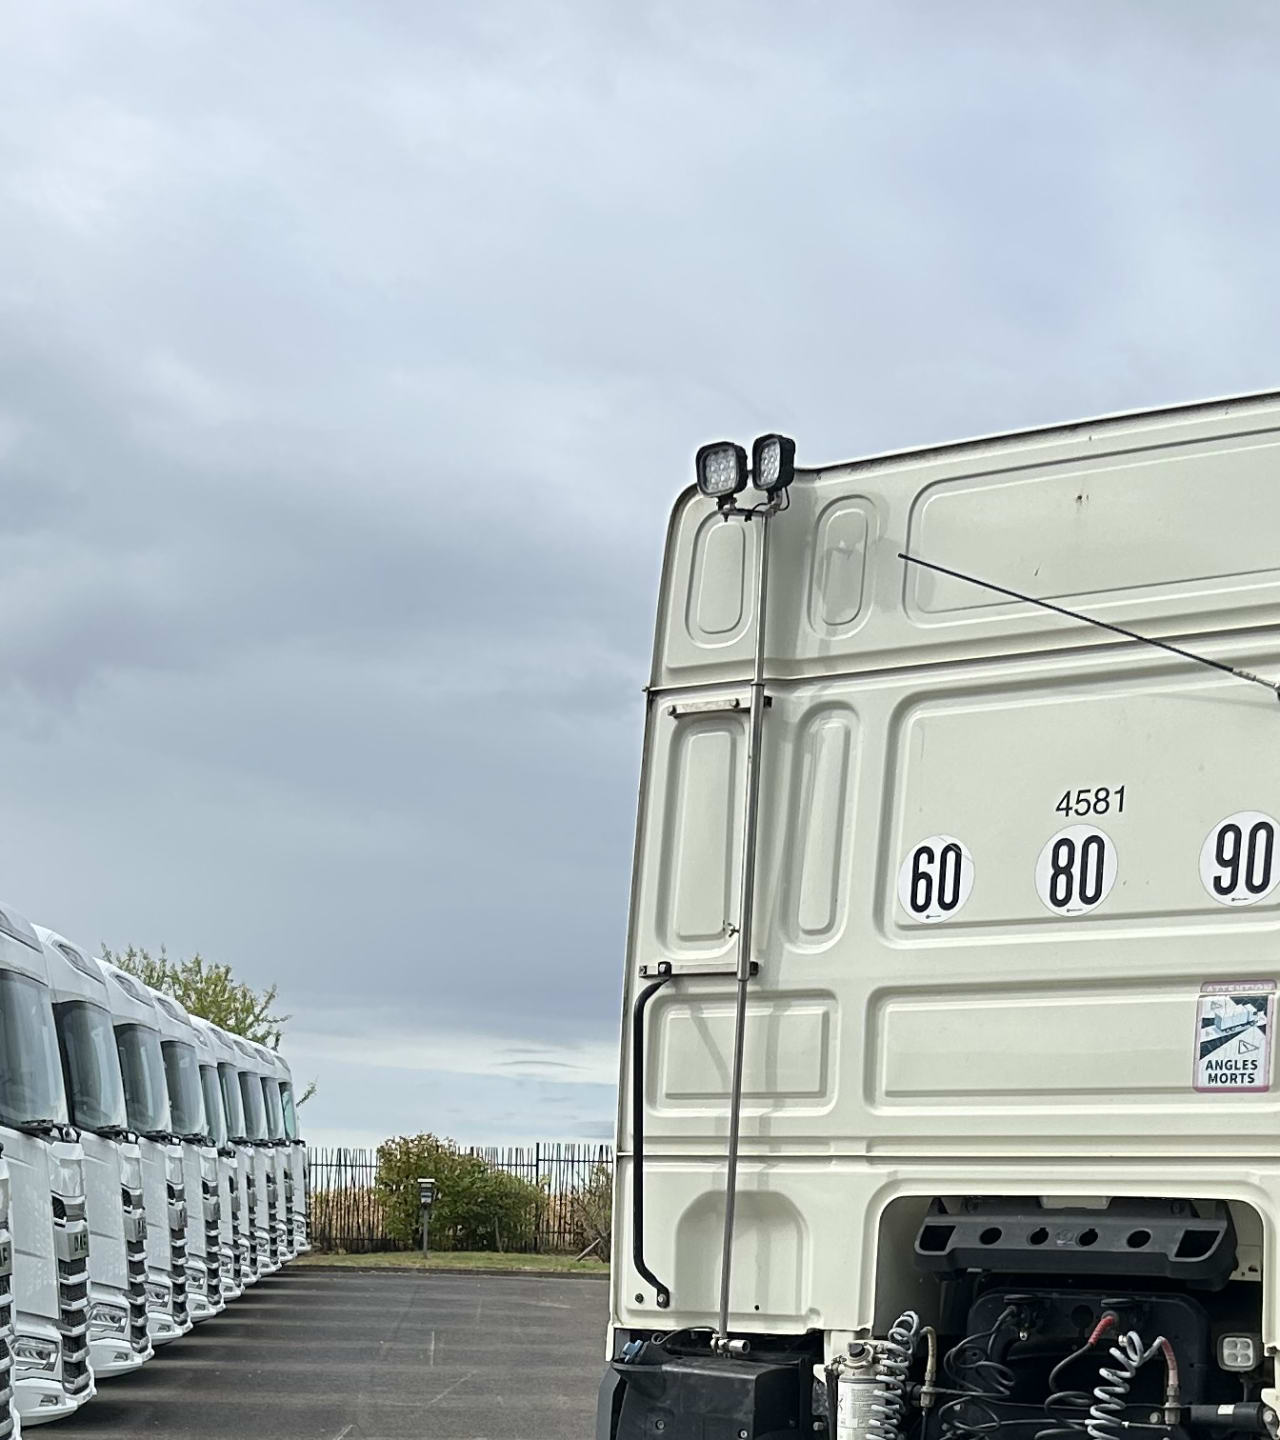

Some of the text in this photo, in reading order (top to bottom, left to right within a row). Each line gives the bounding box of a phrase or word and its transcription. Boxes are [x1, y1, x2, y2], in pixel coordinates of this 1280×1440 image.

[1055, 785, 1125, 817] 4581
[910, 842, 962, 913] 60
[1049, 834, 1106, 907] 80
[1213, 821, 1274, 895] 90
[1205, 1059, 1258, 1071] ANGLES
[1208, 1073, 1255, 1084] MORTS
